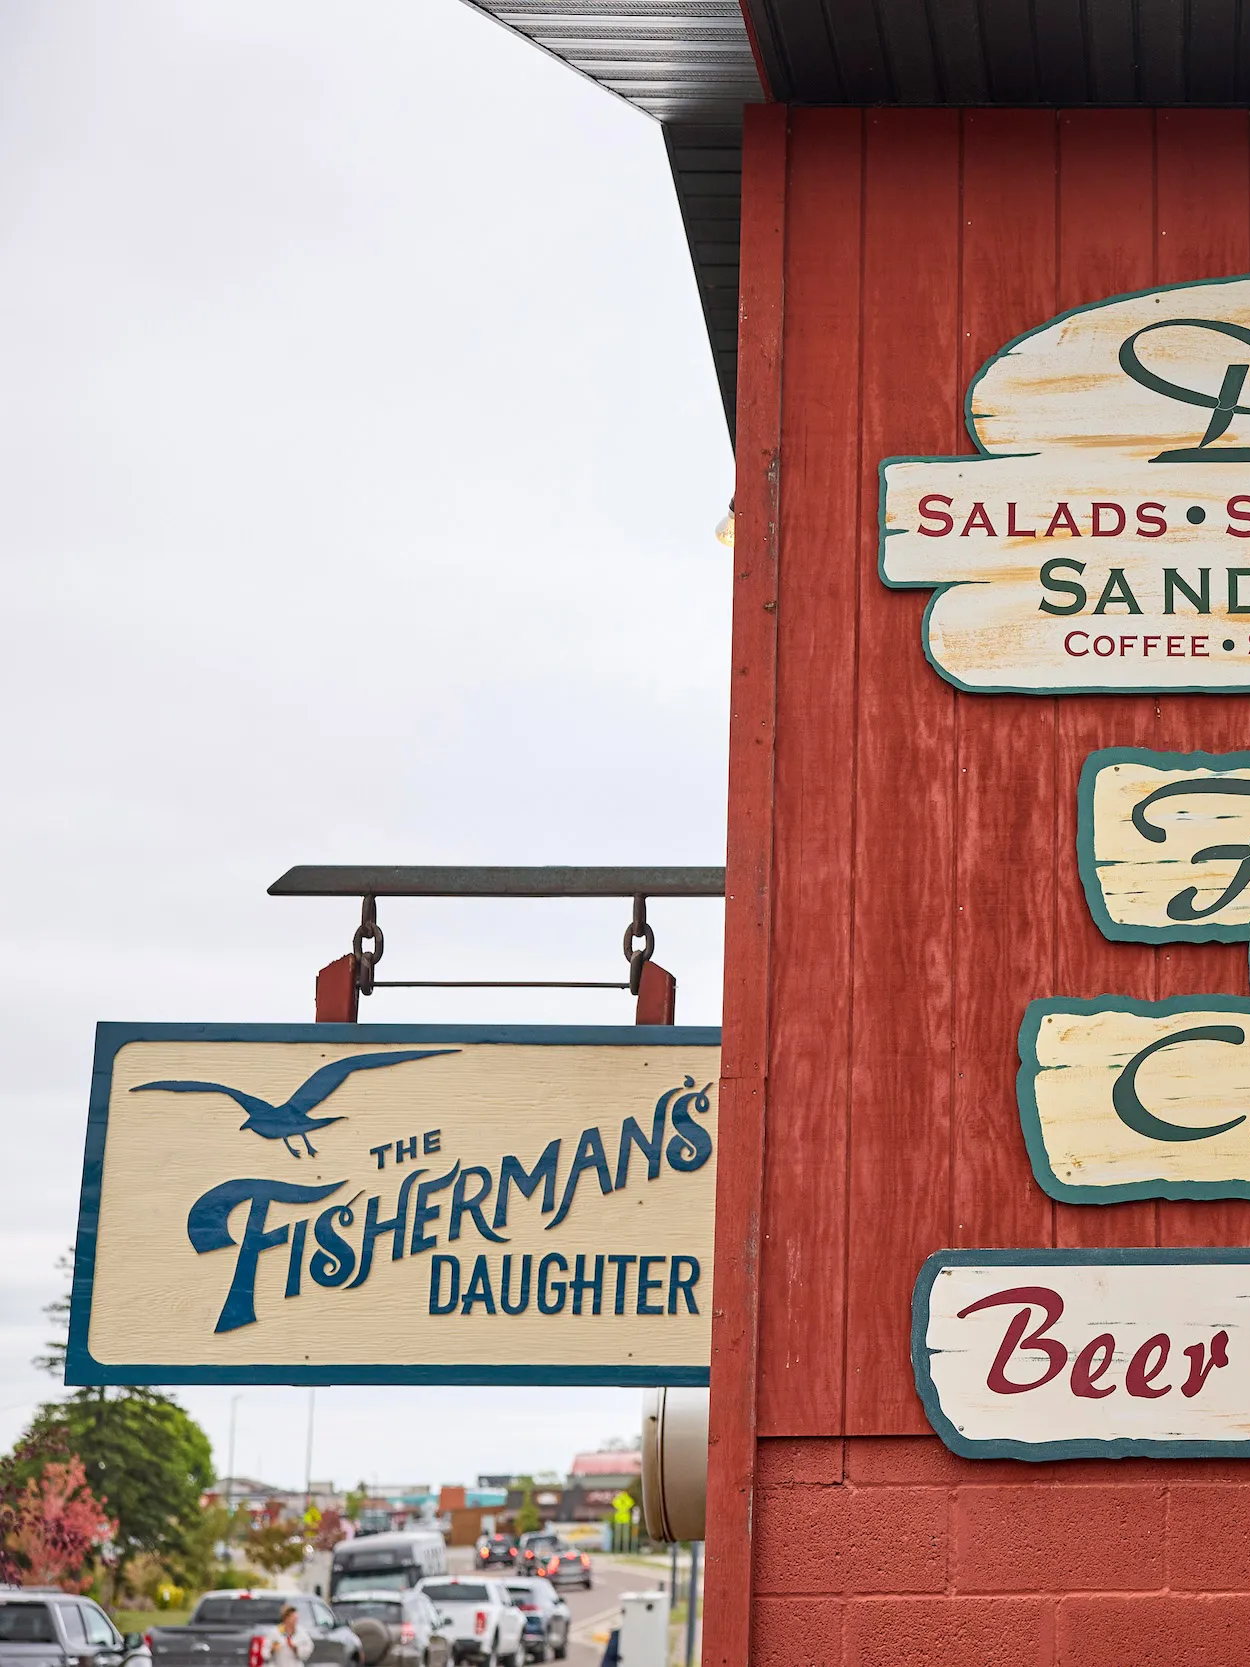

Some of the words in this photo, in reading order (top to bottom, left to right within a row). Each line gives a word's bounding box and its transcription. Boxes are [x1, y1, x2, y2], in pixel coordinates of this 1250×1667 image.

[917, 495, 1167, 538] SALADS
[1064, 631, 1209, 658] COFFEE
[370, 1130, 441, 1169] THE
[188, 1075, 713, 1332] FISHERMAN'S
[429, 1253, 700, 1315] DAUGHTER
[957, 1286, 1228, 1399] Beer
